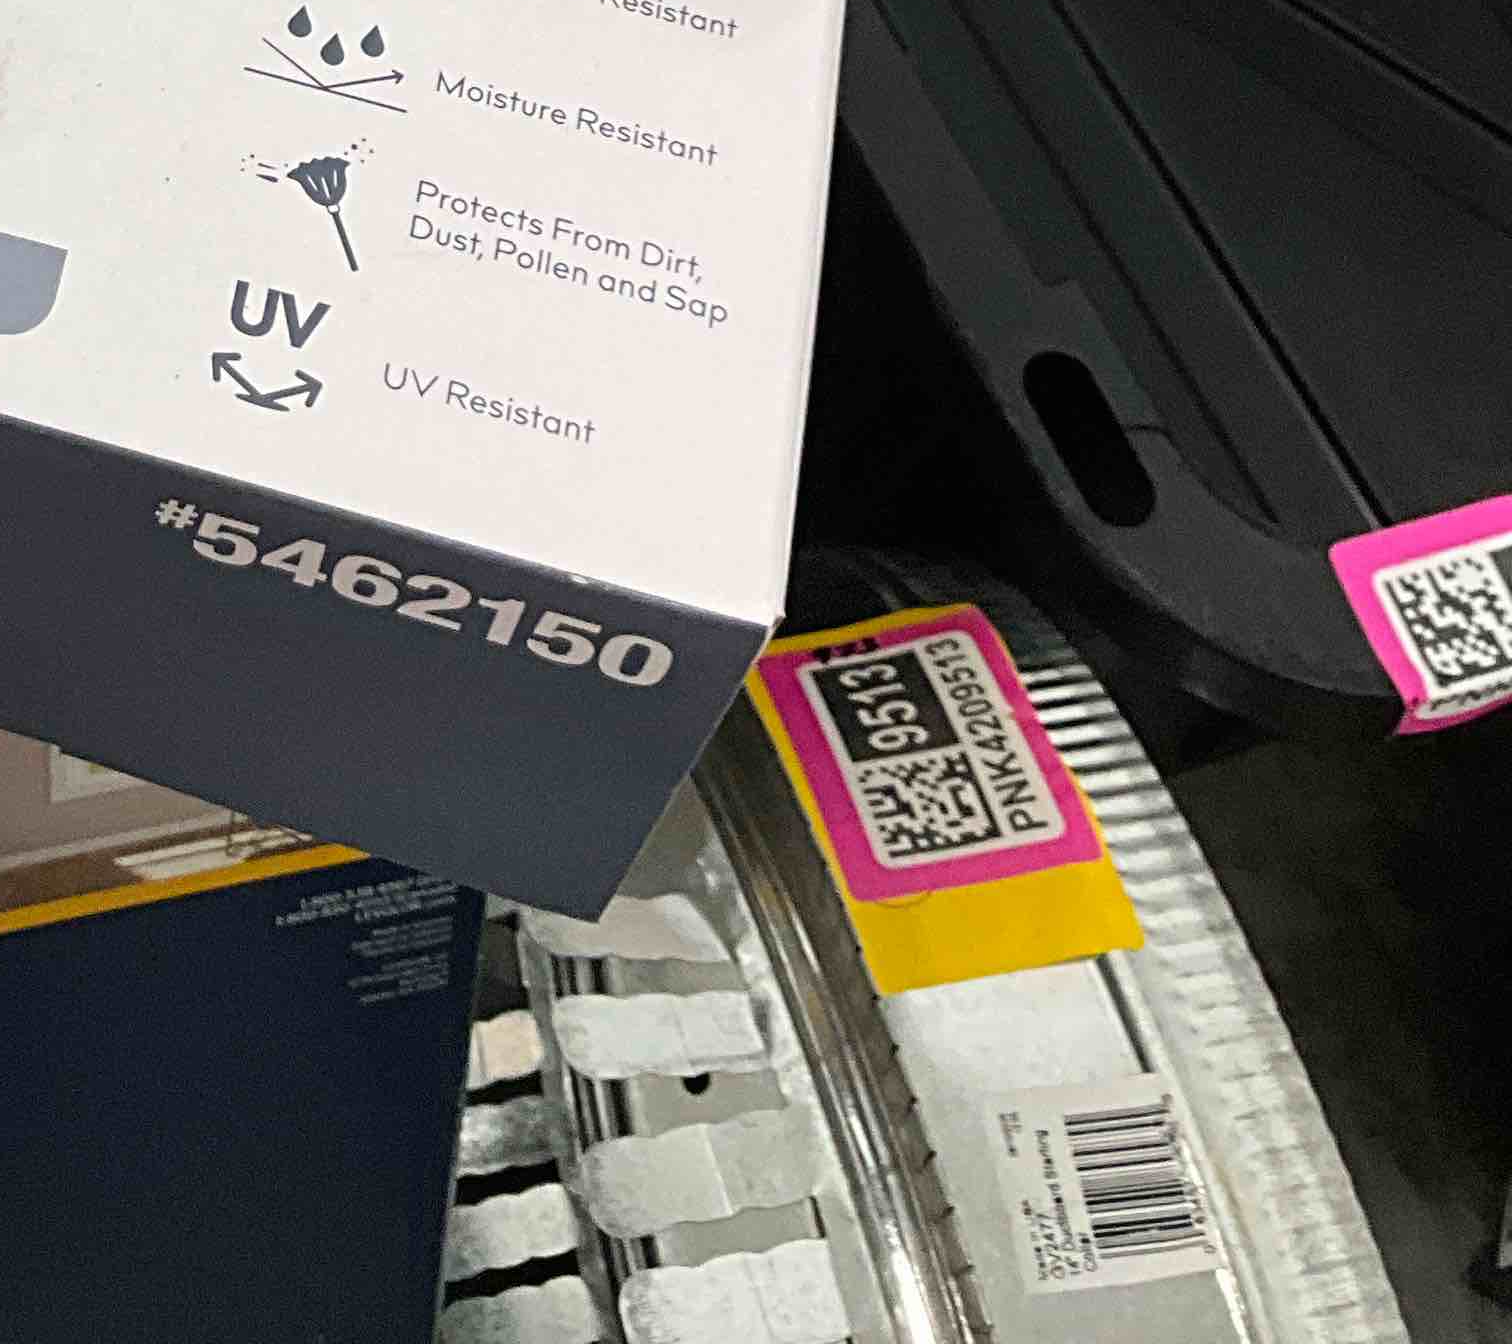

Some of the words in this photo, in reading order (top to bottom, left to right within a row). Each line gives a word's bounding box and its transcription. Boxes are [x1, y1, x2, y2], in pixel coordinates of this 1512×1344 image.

[435, 69, 568, 126] Moisture
[575, 107, 719, 167] Resistant
[408, 213, 484, 262] Dust,
[492, 236, 589, 287] Pollen
[596, 273, 658, 304] and
[663, 284, 729, 329] Sap
[415, 179, 544, 236] Protects
[551, 216, 631, 261] From
[640, 240, 703, 286] Dirt,
[230, 280, 330, 348] UV
[383, 361, 440, 399] UV
[444, 379, 596, 445] Resistant
[154, 499, 674, 687] #5462150
[839, 663, 929, 753] 9513
[924, 638, 1049, 832] PNK4209513
